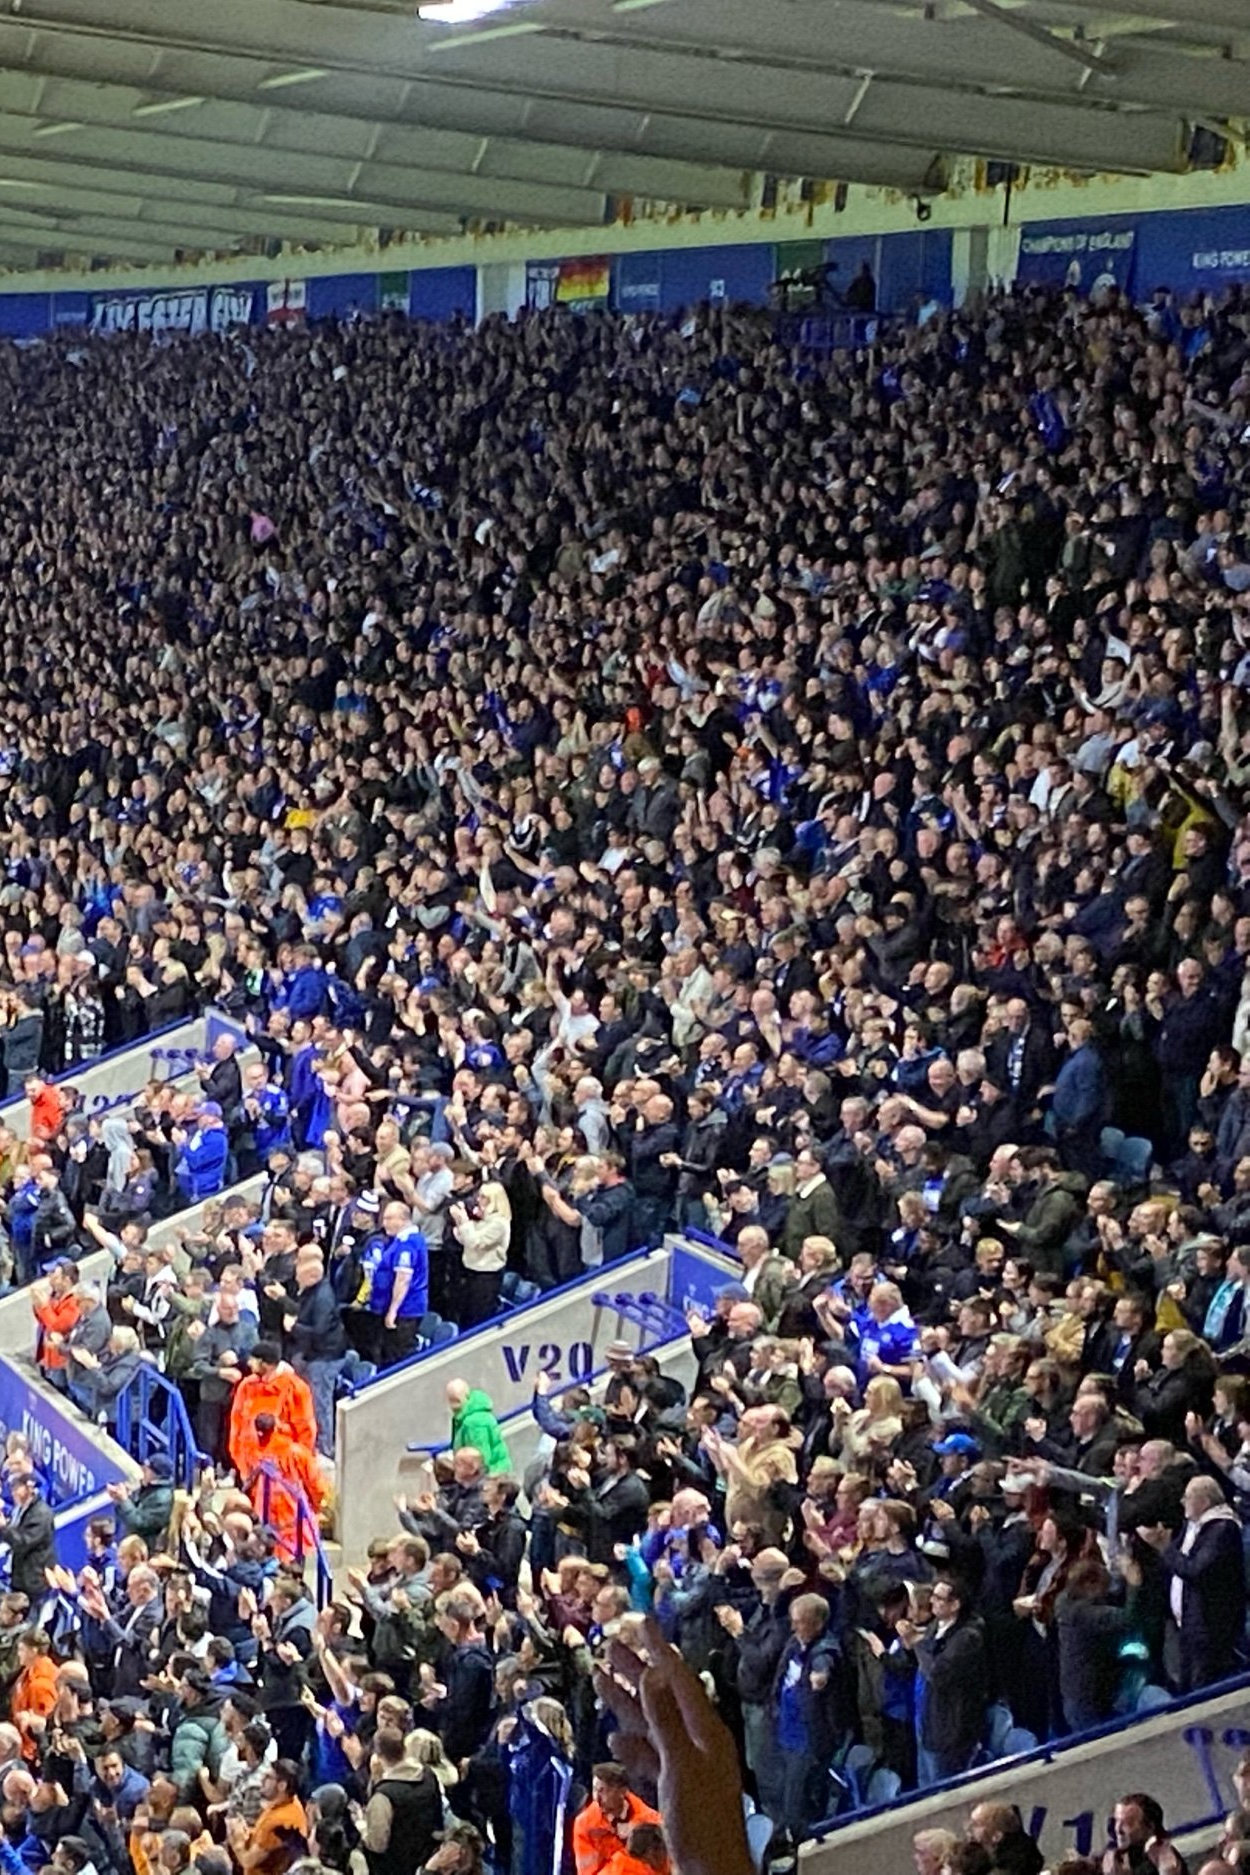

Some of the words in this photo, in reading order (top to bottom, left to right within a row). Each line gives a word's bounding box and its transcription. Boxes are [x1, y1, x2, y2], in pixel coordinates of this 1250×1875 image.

[1219, 249, 1250, 267] POWE
[502, 1341, 594, 1384] V20
[21, 1409, 52, 1466] KING
[52, 1438, 96, 1498] POWER
